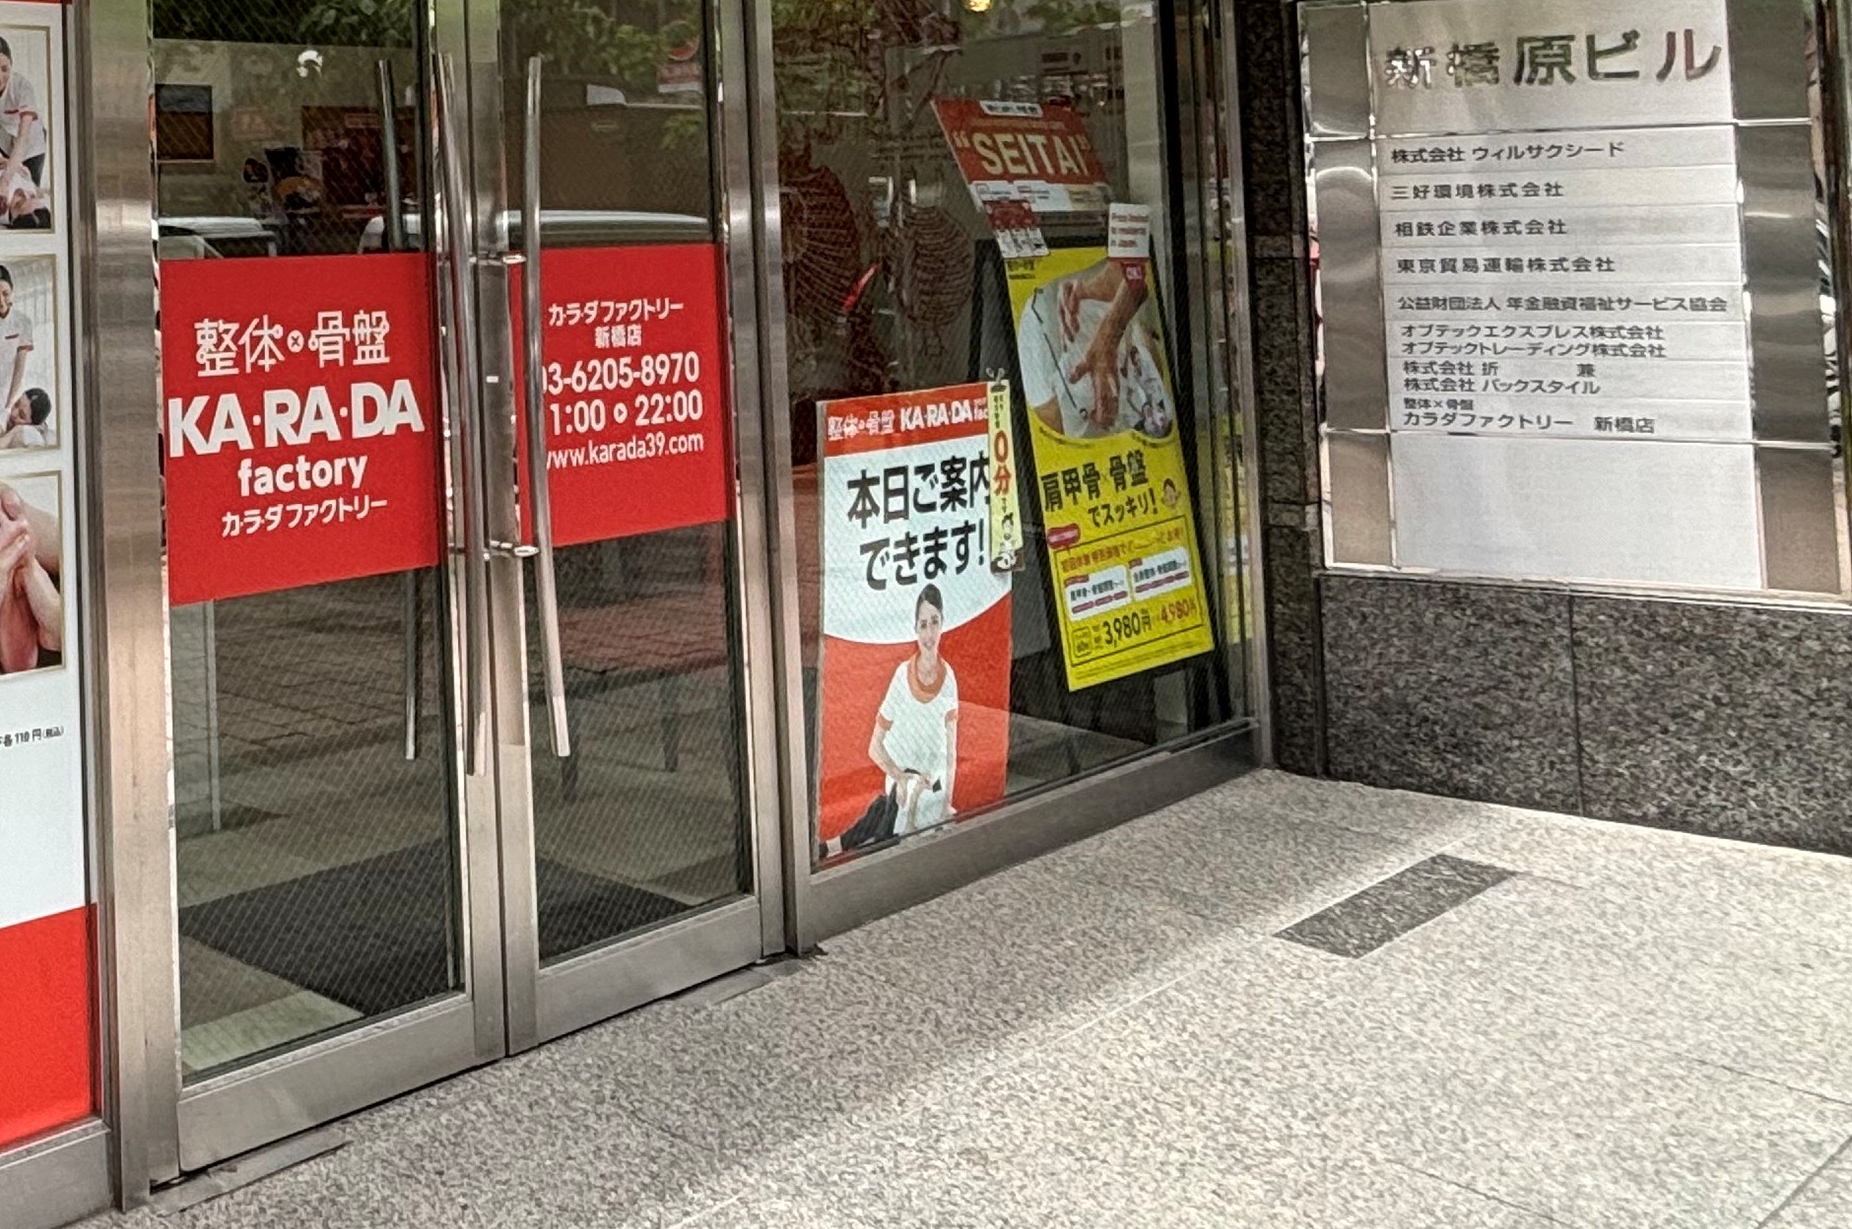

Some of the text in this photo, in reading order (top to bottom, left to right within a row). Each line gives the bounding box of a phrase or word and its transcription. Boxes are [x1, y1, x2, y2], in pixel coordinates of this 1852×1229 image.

[1386, 28, 1723, 89] 新橋原ビル
[1391, 141, 1625, 164] 株式会社 ウィルサクシード
[1398, 296, 1501, 311] 公益財団法人
[594, 323, 642, 349] 新橋店
[541, 351, 700, 396] 3-6205-8970
[1403, 361, 1475, 376] 株式会社
[1404, 377, 1476, 393] 株式会社
[634, 388, 704, 427] 22:00
[1403, 411, 1656, 434] カラダファクトリー 新橋店
[238, 454, 368, 497] factory
[847, 449, 991, 530] 本日ご案内
[859, 517, 985, 592] できます!
